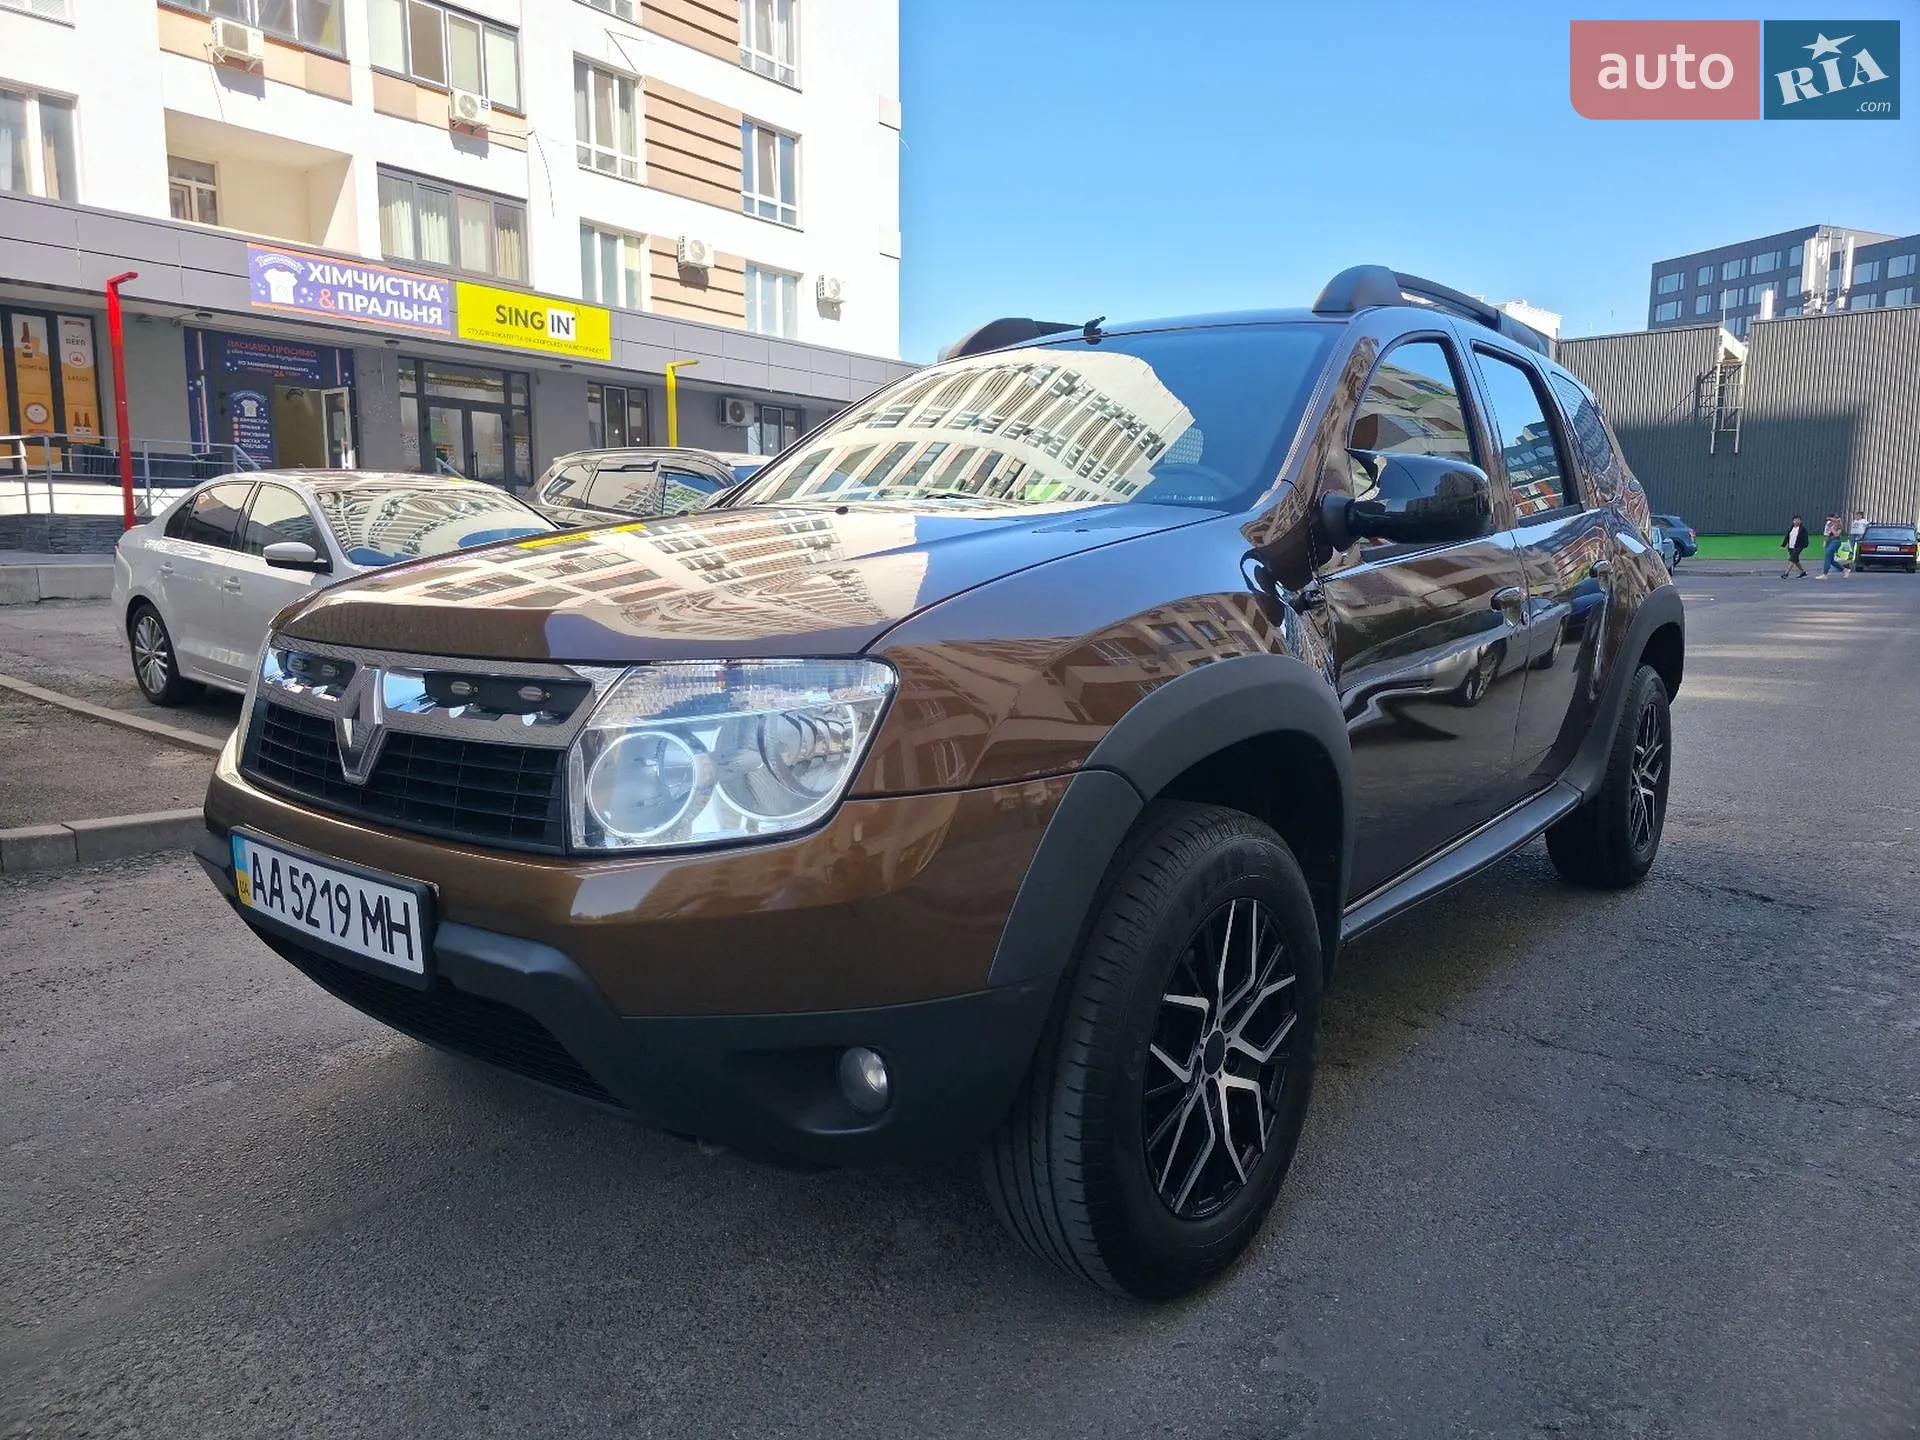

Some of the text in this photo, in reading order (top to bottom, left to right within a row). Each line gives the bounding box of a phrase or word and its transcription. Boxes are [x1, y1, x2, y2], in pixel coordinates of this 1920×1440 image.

[307, 262, 442, 303] ХІМЧИСТКА
[318, 288, 443, 326] & ПРАЛЬНЯ
[495, 304, 545, 330] SING
[289, 865, 351, 938] 5219
[359, 889, 414, 961] MH
